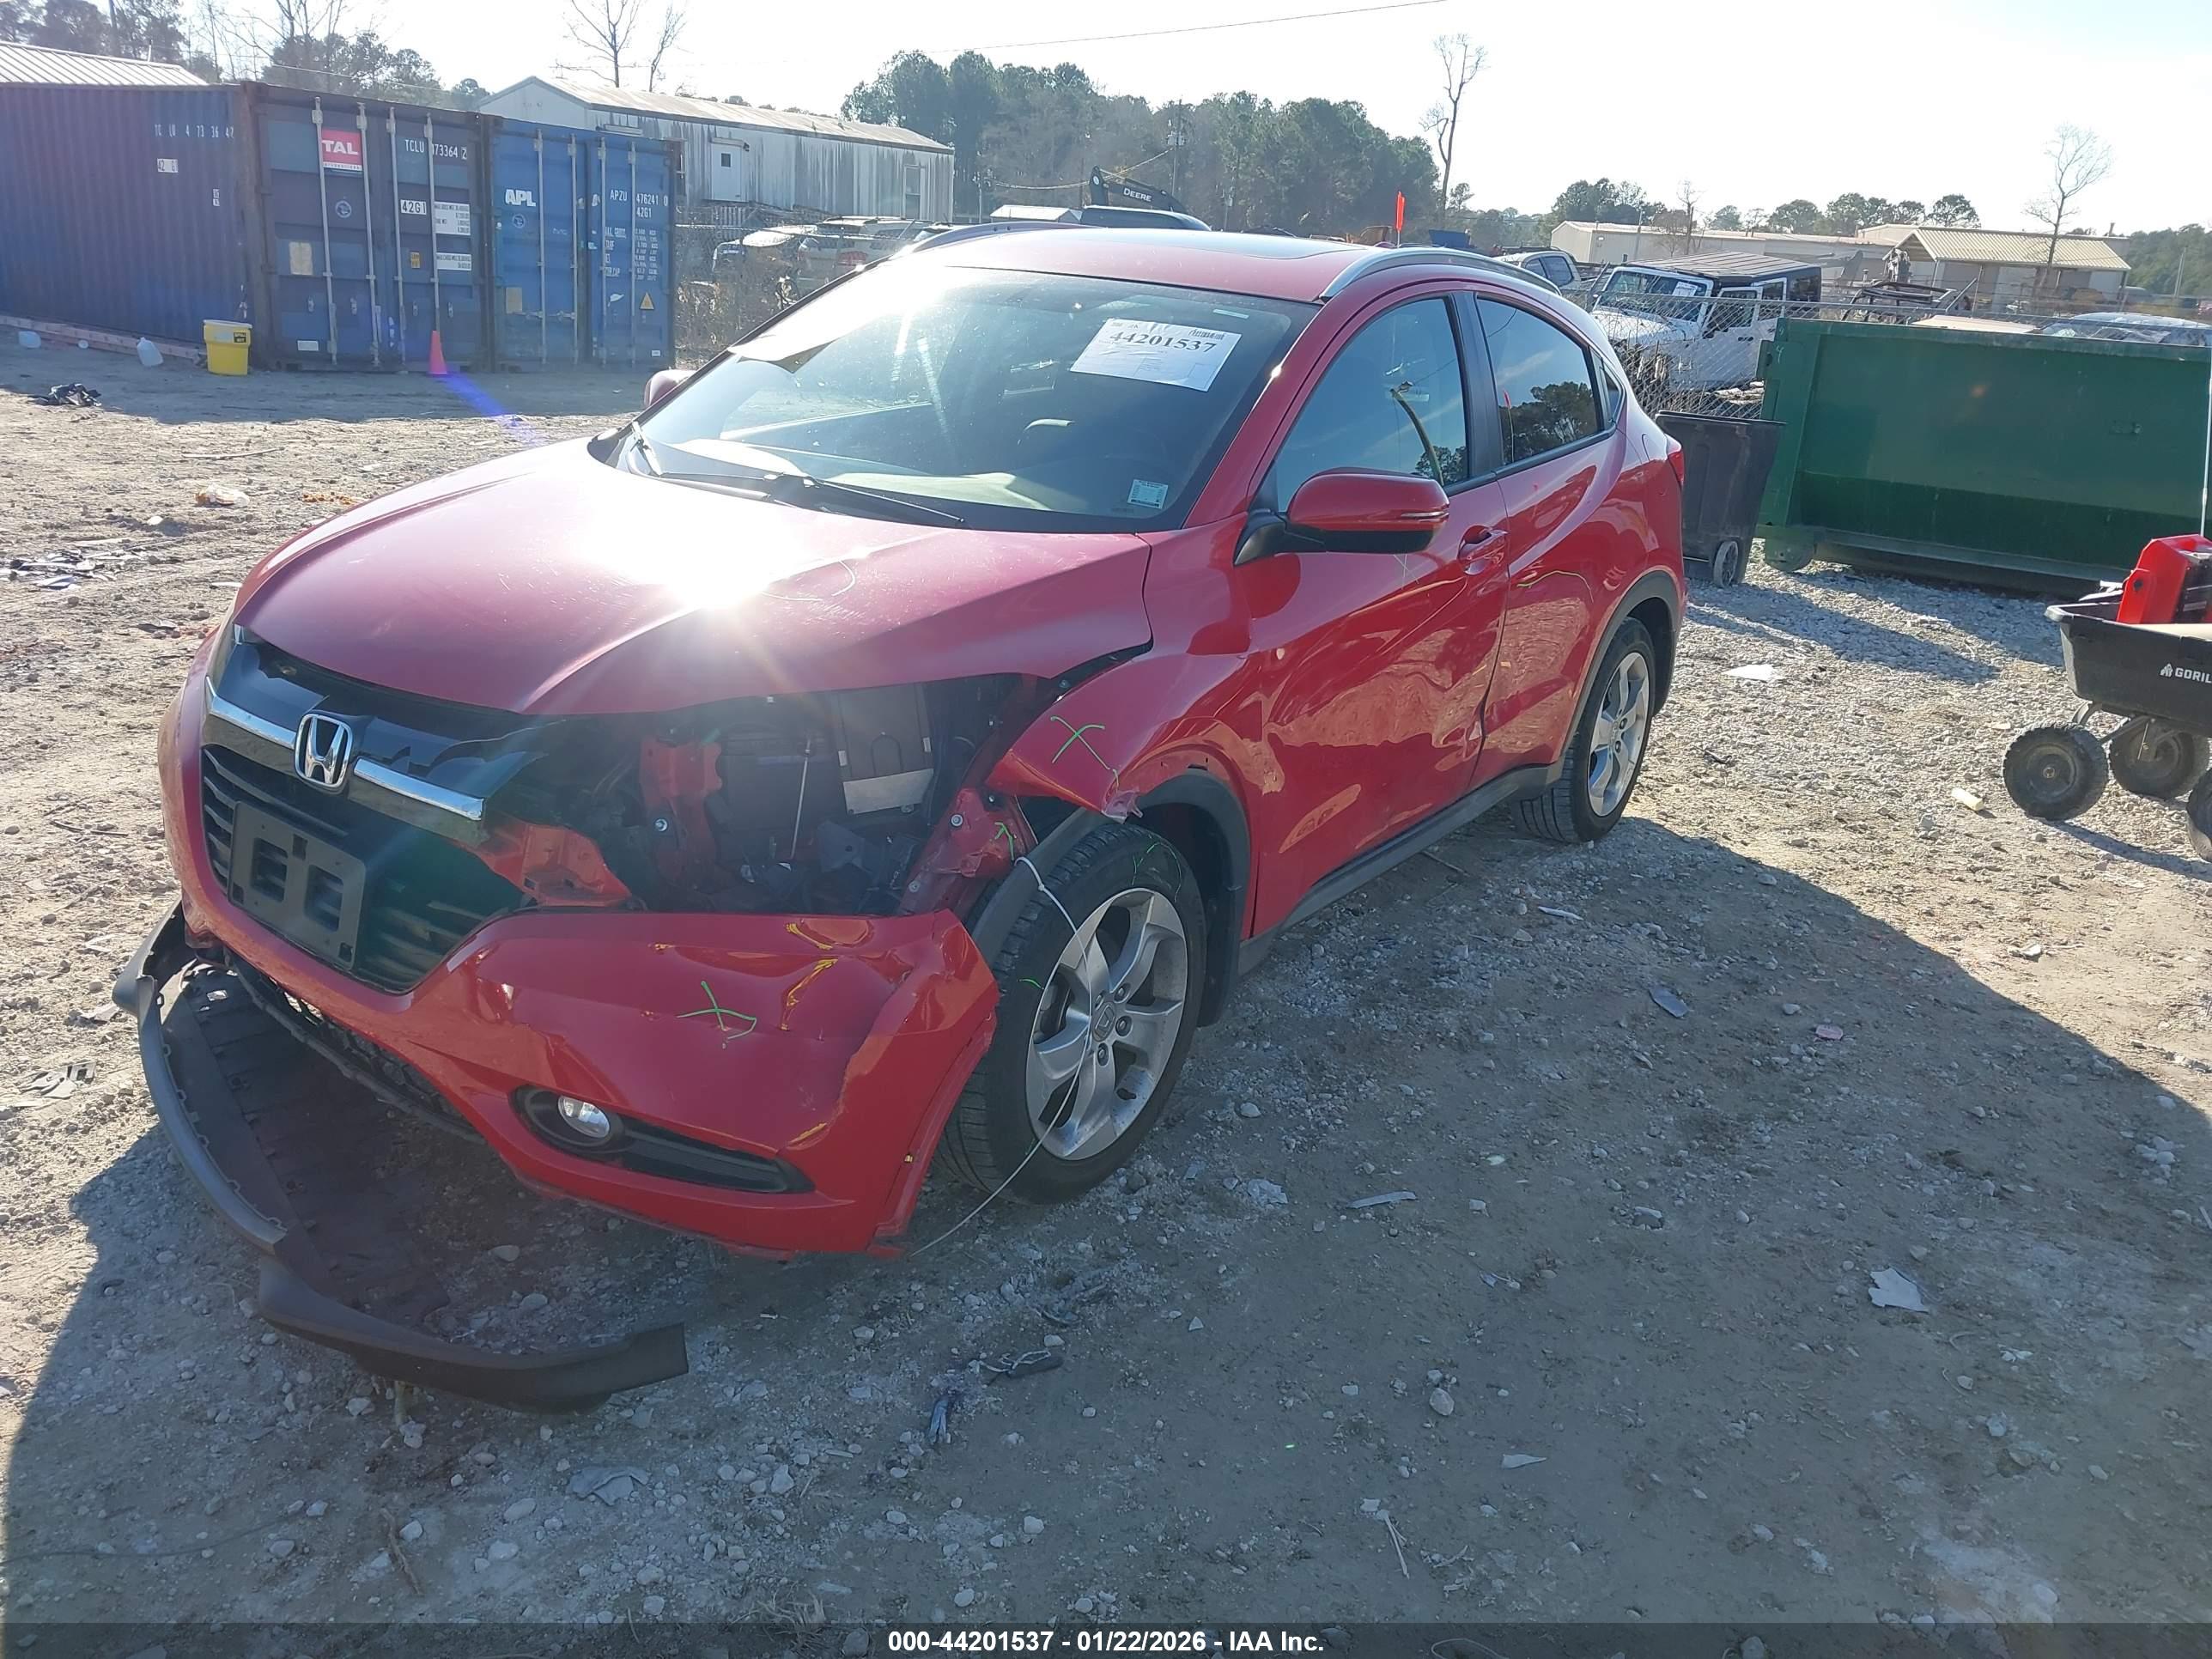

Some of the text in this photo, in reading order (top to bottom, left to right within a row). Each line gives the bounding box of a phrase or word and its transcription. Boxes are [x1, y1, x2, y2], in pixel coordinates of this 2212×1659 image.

[322, 140, 359, 155] TAL
[405, 139, 425, 153] TCLU
[505, 189, 537, 207] APL
[610, 190, 628, 202] APZU
[636, 193, 659, 205] 476241
[1123, 187, 1152, 203] DEERE
[402, 200, 426, 214] 42G1
[1110, 331, 1218, 353] 44201537
[2175, 667, 2212, 684] GORIL
